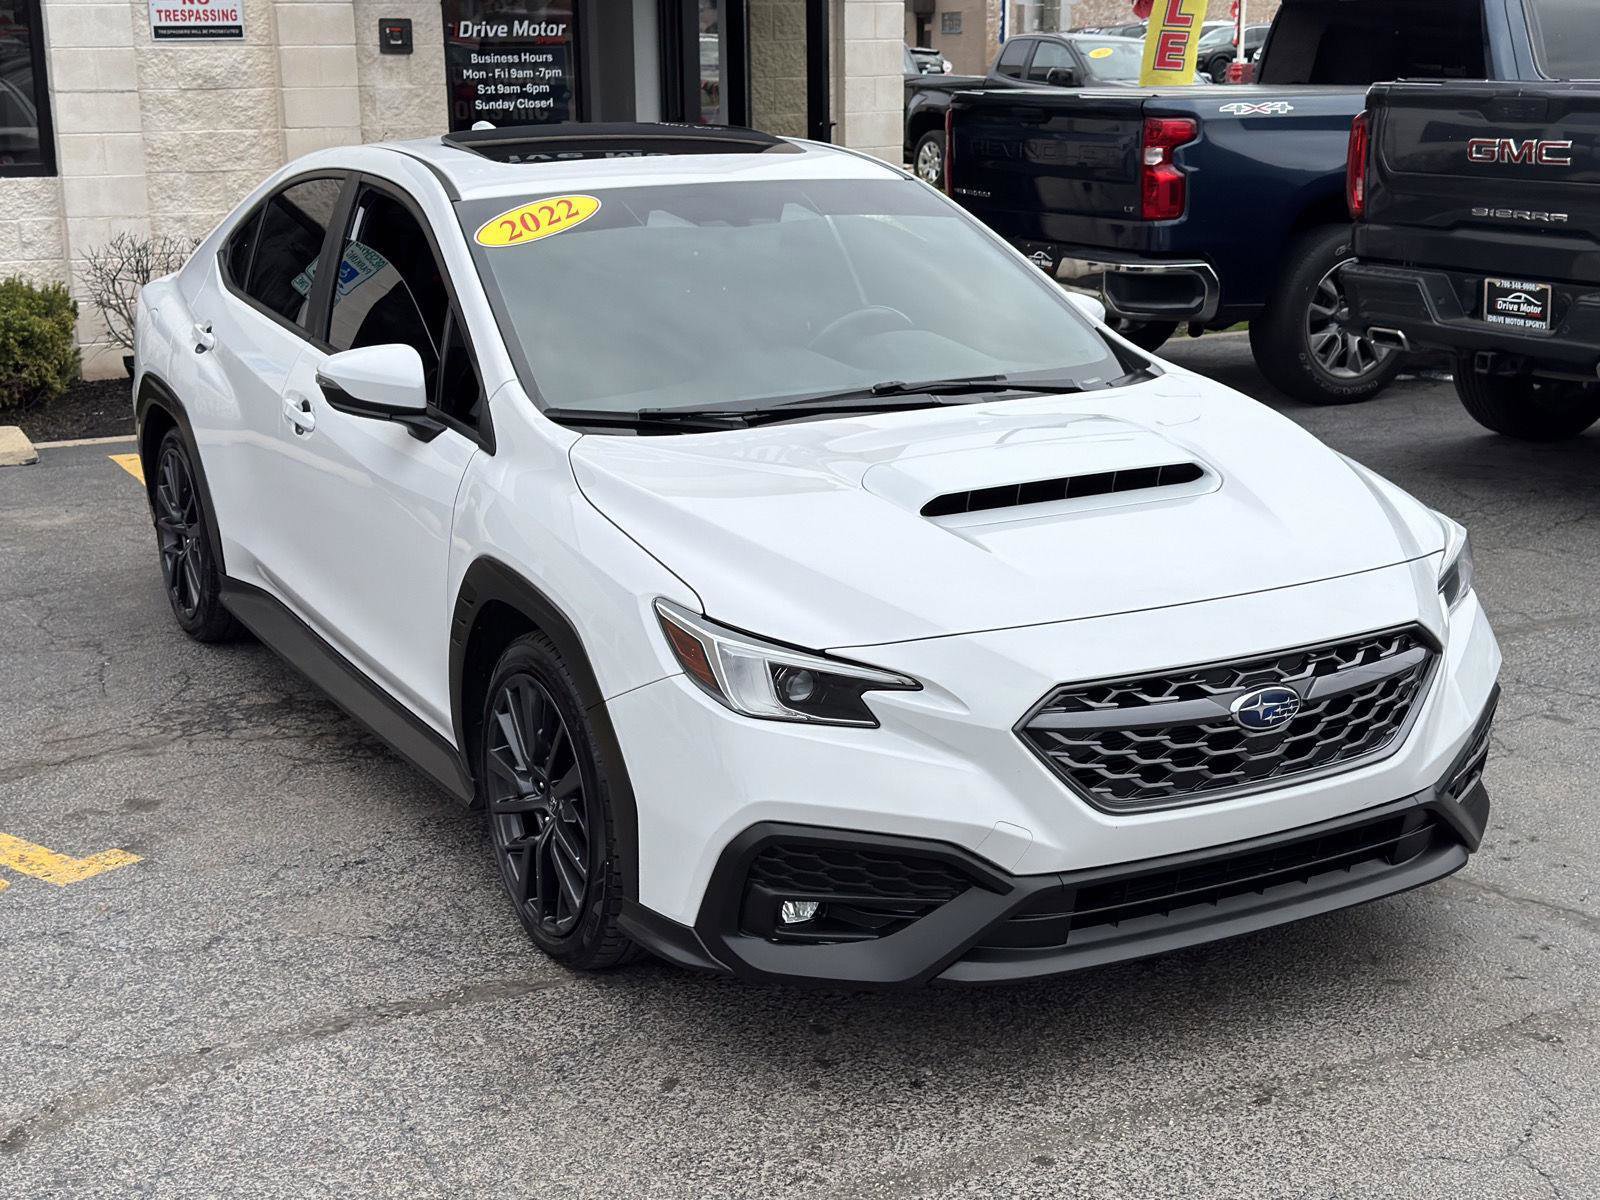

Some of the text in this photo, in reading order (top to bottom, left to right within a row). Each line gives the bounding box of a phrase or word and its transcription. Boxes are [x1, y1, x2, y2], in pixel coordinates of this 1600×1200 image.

[156, 9, 238, 22] TRESPASSING
[513, 20, 567, 37] Motor
[470, 52, 553, 64] Business Hours
[463, 69, 486, 79] Mon
[510, 69, 533, 79] 9am
[477, 84, 495, 95] Sat
[497, 84, 521, 94] 9am
[475, 99, 515, 111] Sunday
[516, 98, 554, 108] Closed
[1467, 138, 1573, 166] GMC
[499, 200, 580, 241] 2022
[1471, 207, 1568, 222] SIERRA
[1497, 301, 1542, 313] Drive Motor
[1505, 317, 1525, 326] MOTOR
[1525, 320, 1546, 329] SPORTS
